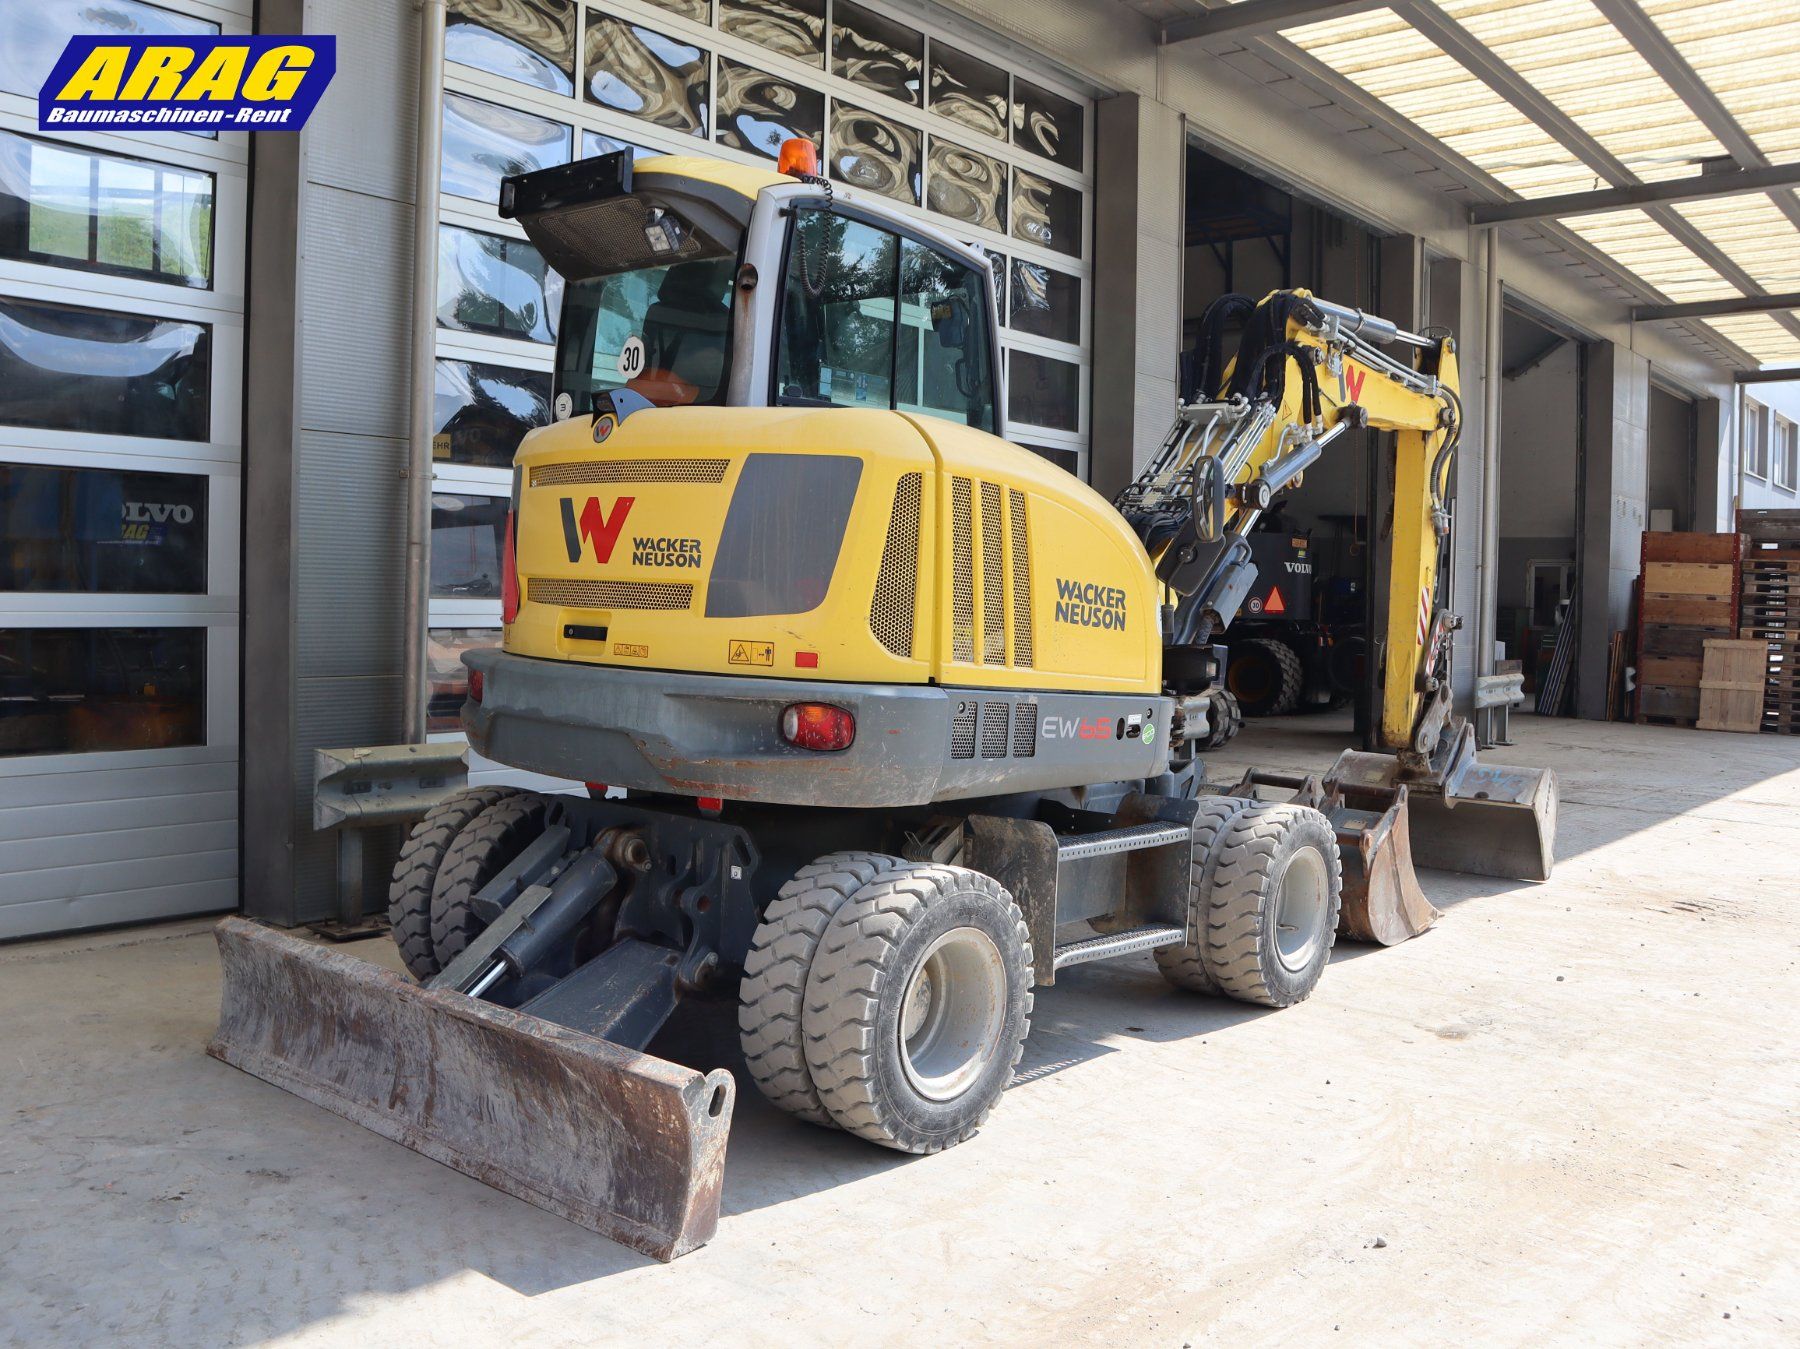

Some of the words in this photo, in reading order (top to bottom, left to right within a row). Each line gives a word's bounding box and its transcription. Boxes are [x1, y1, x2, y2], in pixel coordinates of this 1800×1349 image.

[623, 346, 640, 372] 30
[121, 502, 194, 524] LVO
[632, 537, 702, 553] WACKER
[632, 552, 702, 568] NEUSON
[1055, 578, 1126, 611] WACKER
[1055, 601, 1126, 632] NEUSON
[1041, 717, 1112, 740] EW65
